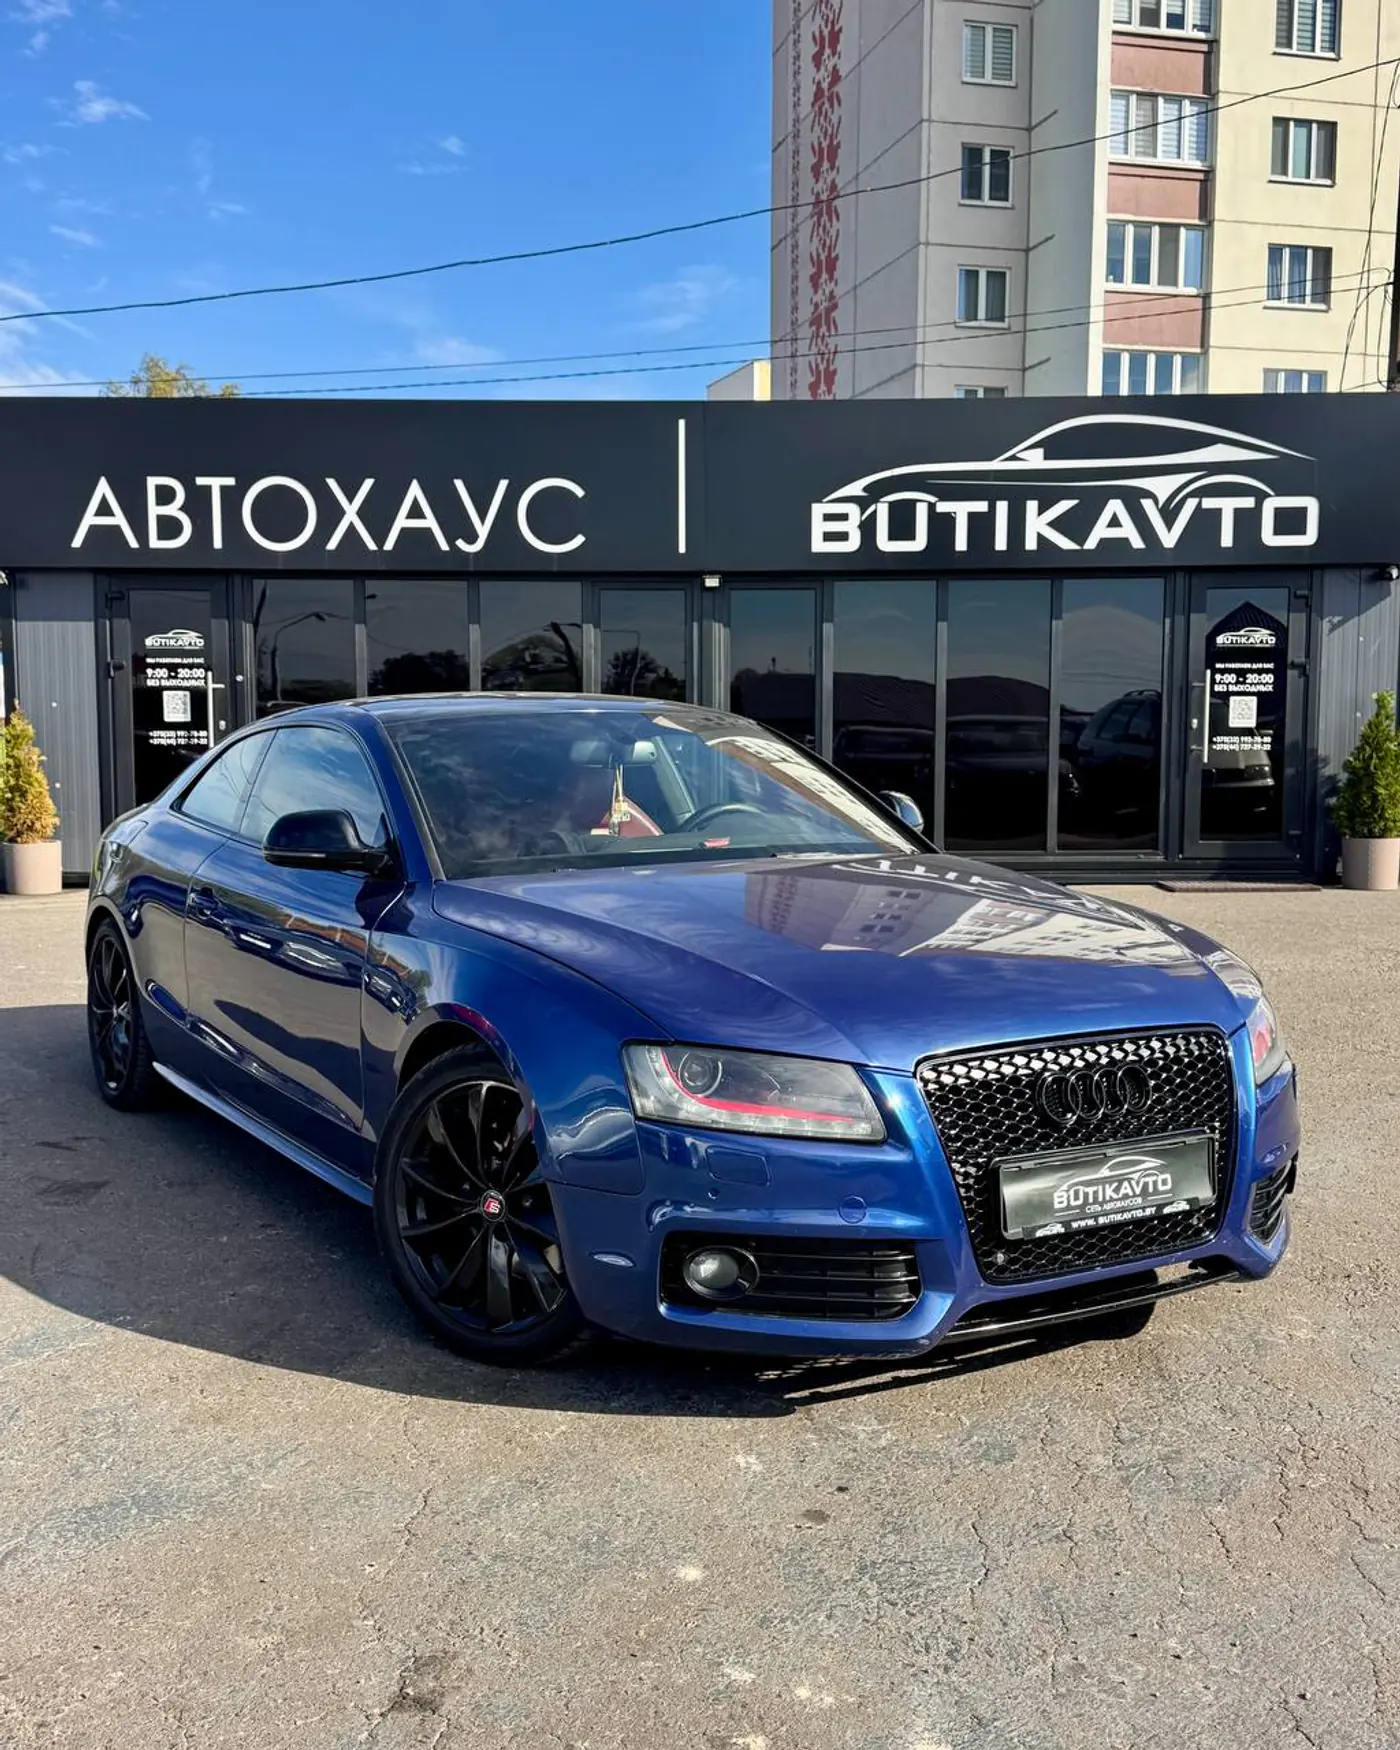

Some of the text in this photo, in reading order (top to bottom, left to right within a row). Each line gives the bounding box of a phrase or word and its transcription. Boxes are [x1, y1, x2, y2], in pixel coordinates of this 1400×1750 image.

[71, 476, 587, 554] АВТОХАУС
[811, 495, 1320, 553] BUTIKAVTO
[145, 638, 205, 647] BUTIKAVTO
[1216, 636, 1276, 645] BUTIKAVTO
[146, 668, 168, 678] 9:00
[177, 668, 205, 678] 20:00
[161, 679, 205, 687] ВЫХОДНЫХ
[1214, 673, 1236, 683] 9:00
[1245, 673, 1274, 684] 20:00
[1214, 684, 1274, 692] БЕЗ ВЫХОДНЫХ
[1053, 1173, 1172, 1209] BUTIKAVTO
[1071, 1217, 1096, 1229] WWW.
